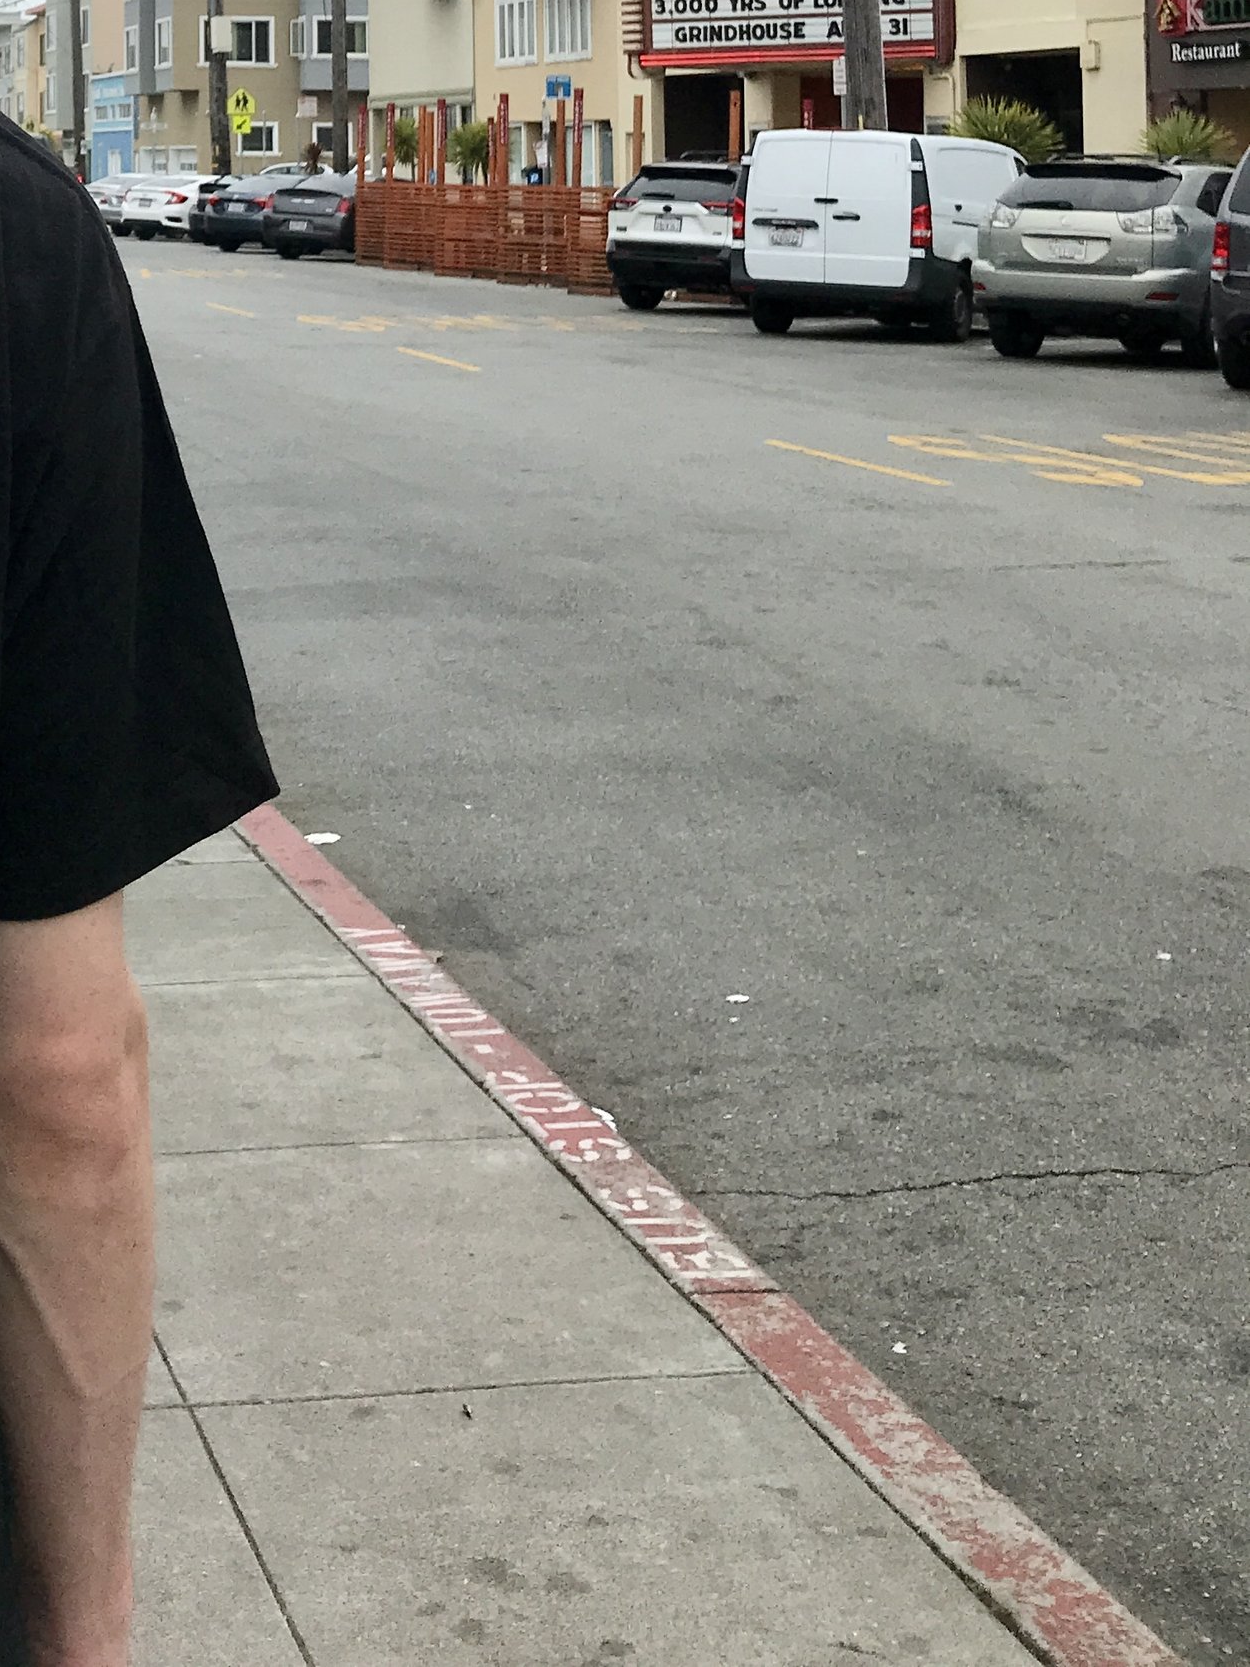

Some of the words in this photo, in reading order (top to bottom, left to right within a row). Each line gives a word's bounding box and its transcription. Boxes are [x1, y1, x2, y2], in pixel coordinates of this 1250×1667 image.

[674, 21, 806, 43] GRINDHOUSE
[888, 17, 908, 36] 31
[1171, 41, 1240, 62] Restaurant
[886, 428, 1250, 488] SLO
[404, 991, 507, 1038] TOW
[484, 1070, 633, 1163] STOP
[599, 1185, 756, 1278] BUS
